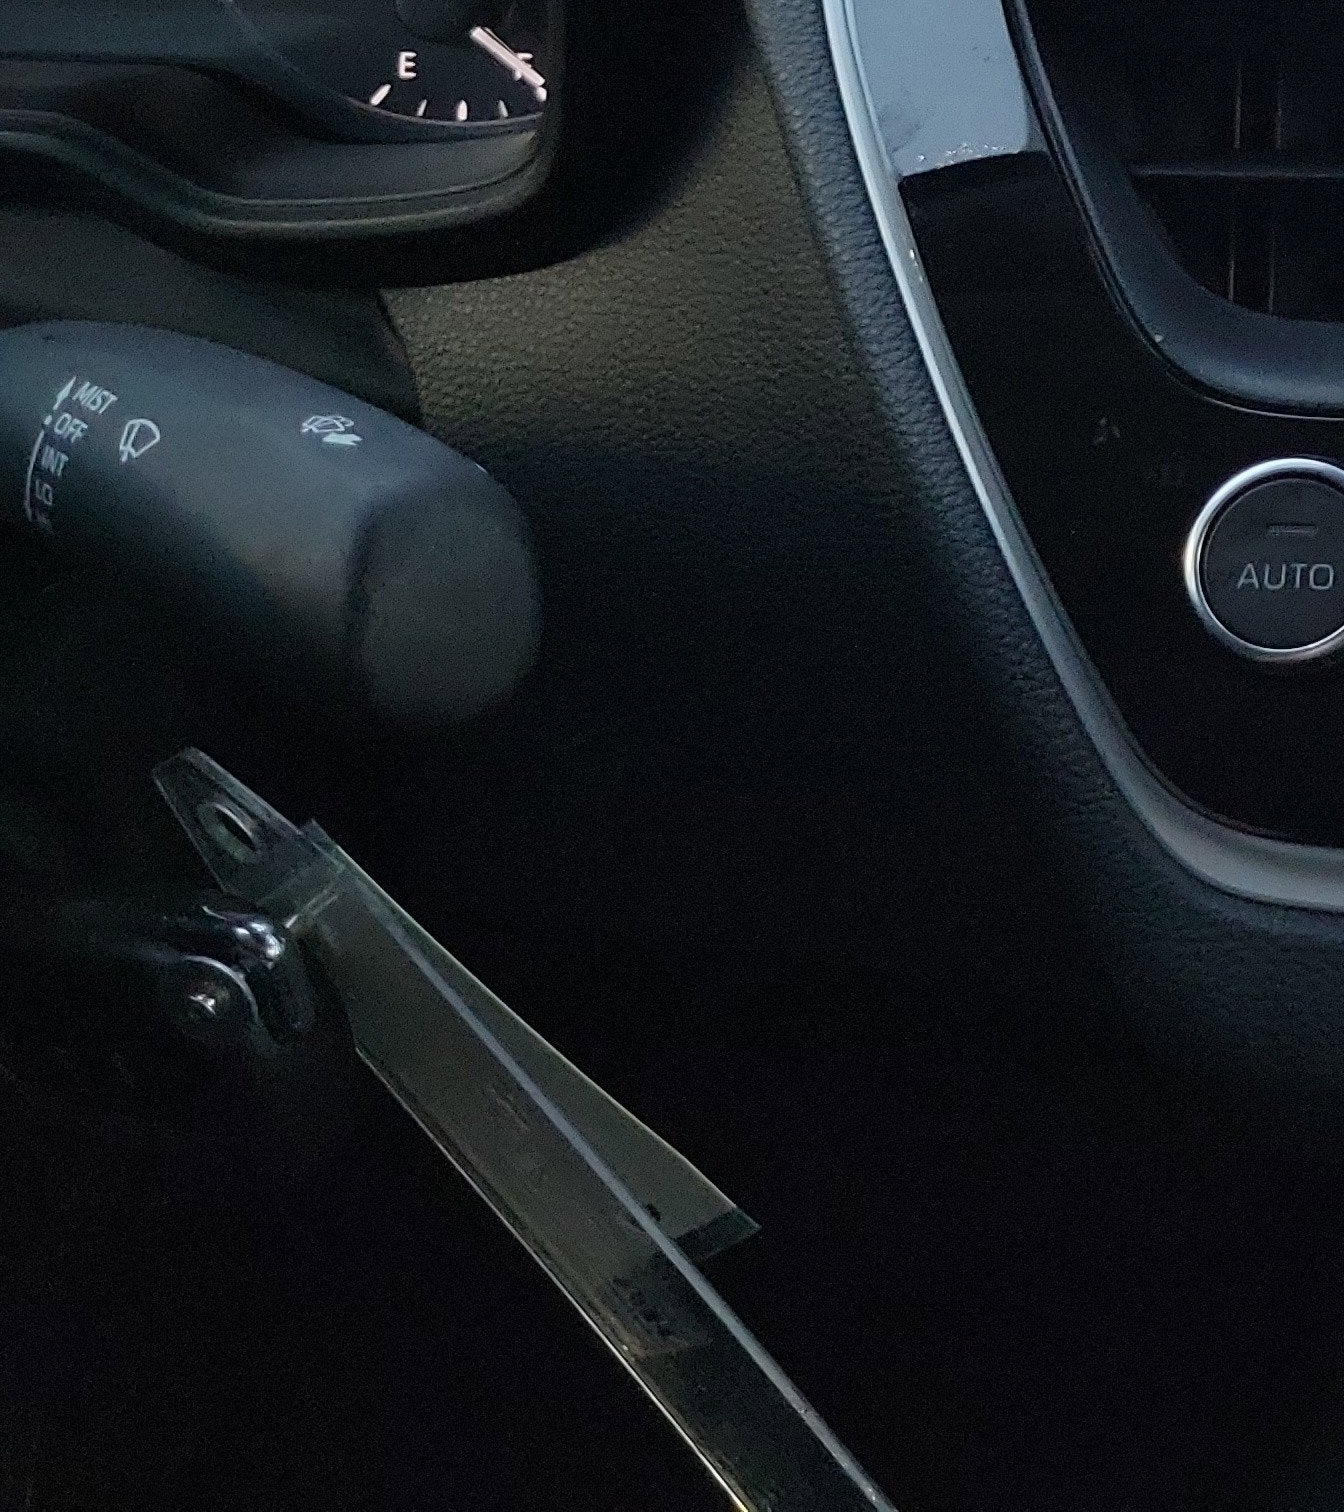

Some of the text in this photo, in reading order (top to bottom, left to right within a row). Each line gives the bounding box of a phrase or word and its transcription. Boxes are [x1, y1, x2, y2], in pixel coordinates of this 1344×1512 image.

[398, 51, 417, 80] E
[72, 381, 118, 414] MIST
[54, 412, 88, 443] OFF
[41, 444, 69, 477] INT
[1236, 563, 1334, 591] AUTO
